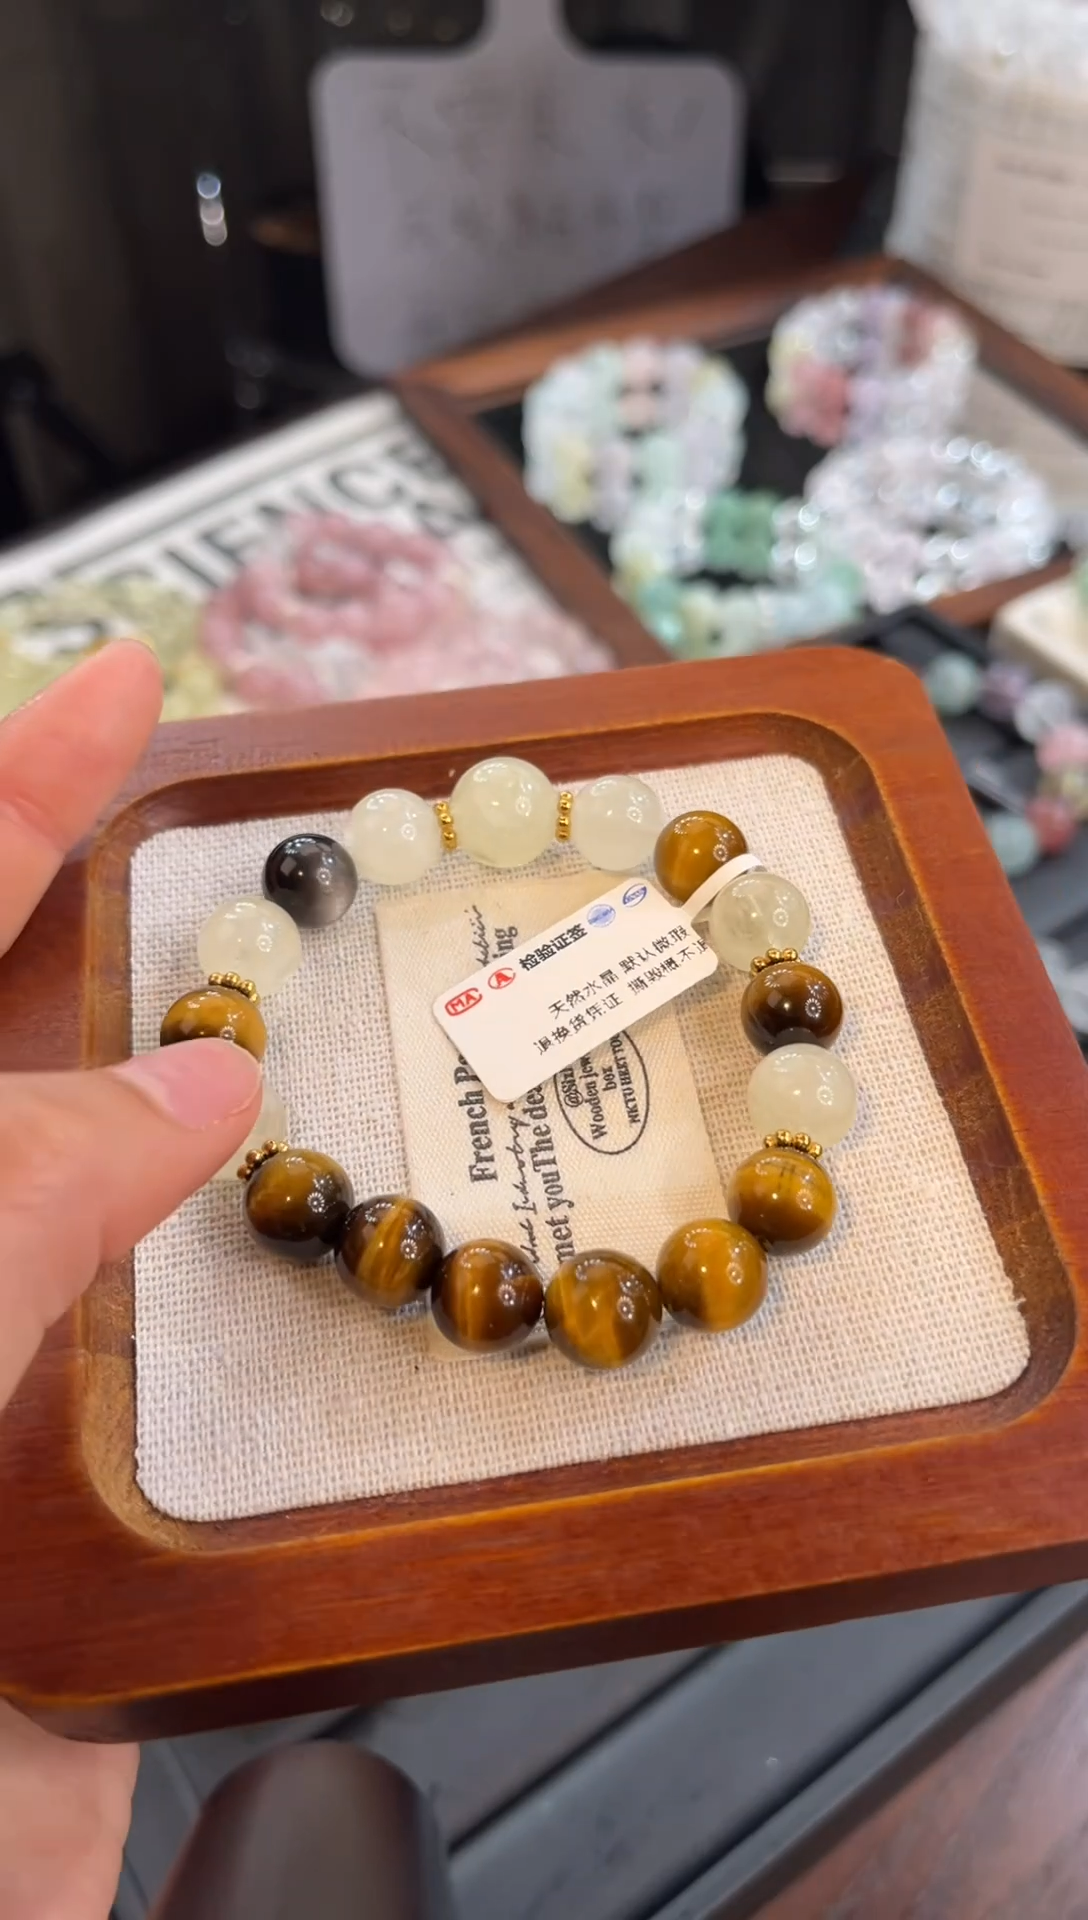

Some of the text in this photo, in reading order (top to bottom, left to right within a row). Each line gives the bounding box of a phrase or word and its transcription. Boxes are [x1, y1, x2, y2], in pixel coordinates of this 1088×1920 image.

[519, 923, 588, 971] 检验证签
[547, 925, 690, 1019] 天然水晶 默认微瑕
[533, 992, 623, 1055] 退换货凭证
[602, 1065, 617, 1092] box
[458, 1089, 498, 1182] French
[584, 1081, 607, 1140] Wooden
